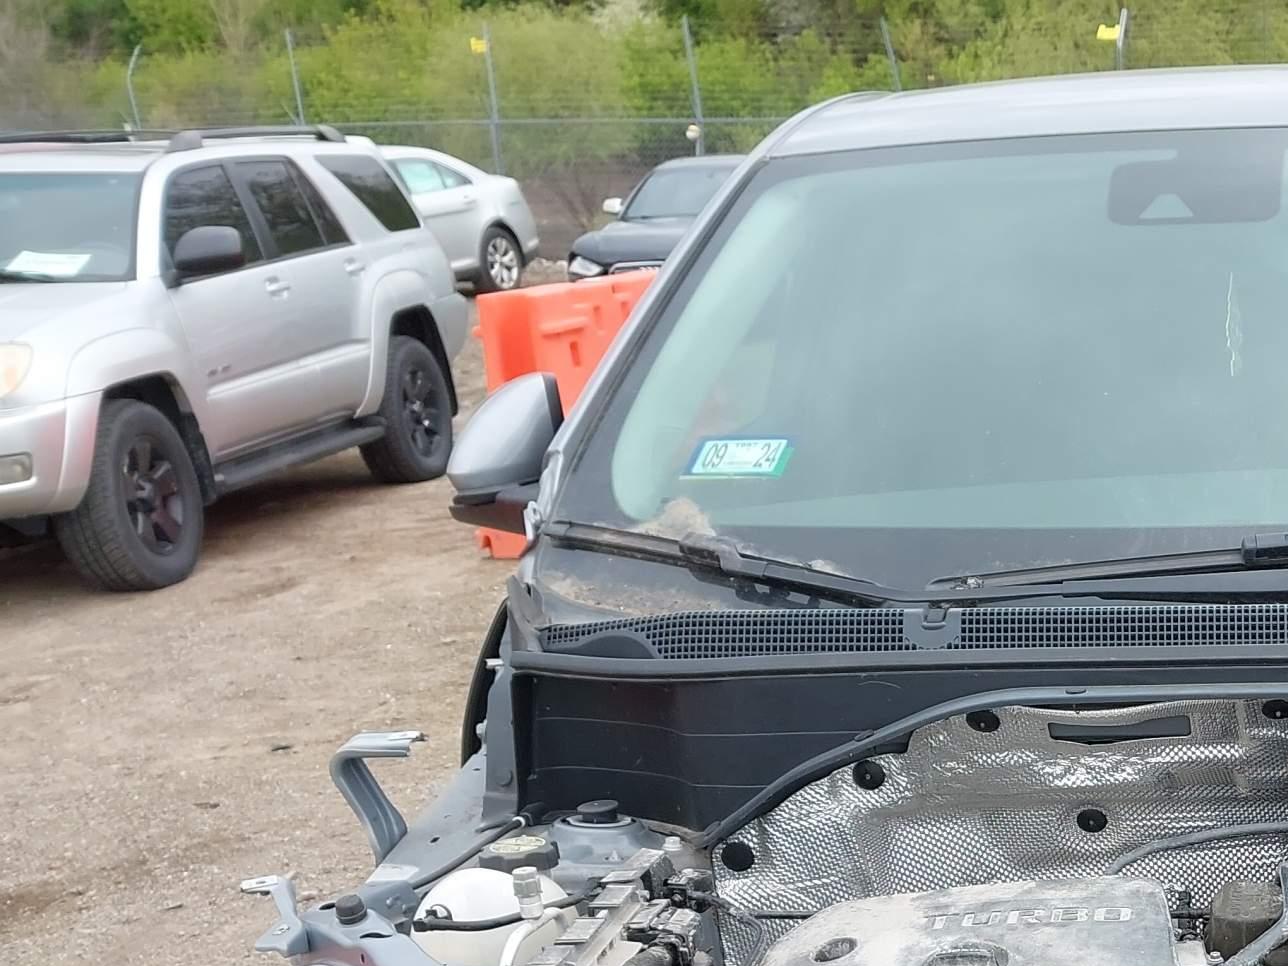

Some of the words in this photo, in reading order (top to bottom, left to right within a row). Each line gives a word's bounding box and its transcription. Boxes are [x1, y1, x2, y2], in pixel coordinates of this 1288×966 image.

[702, 443, 728, 469] 09
[752, 442, 782, 469] 24
[924, 906, 1134, 930] TURBO
